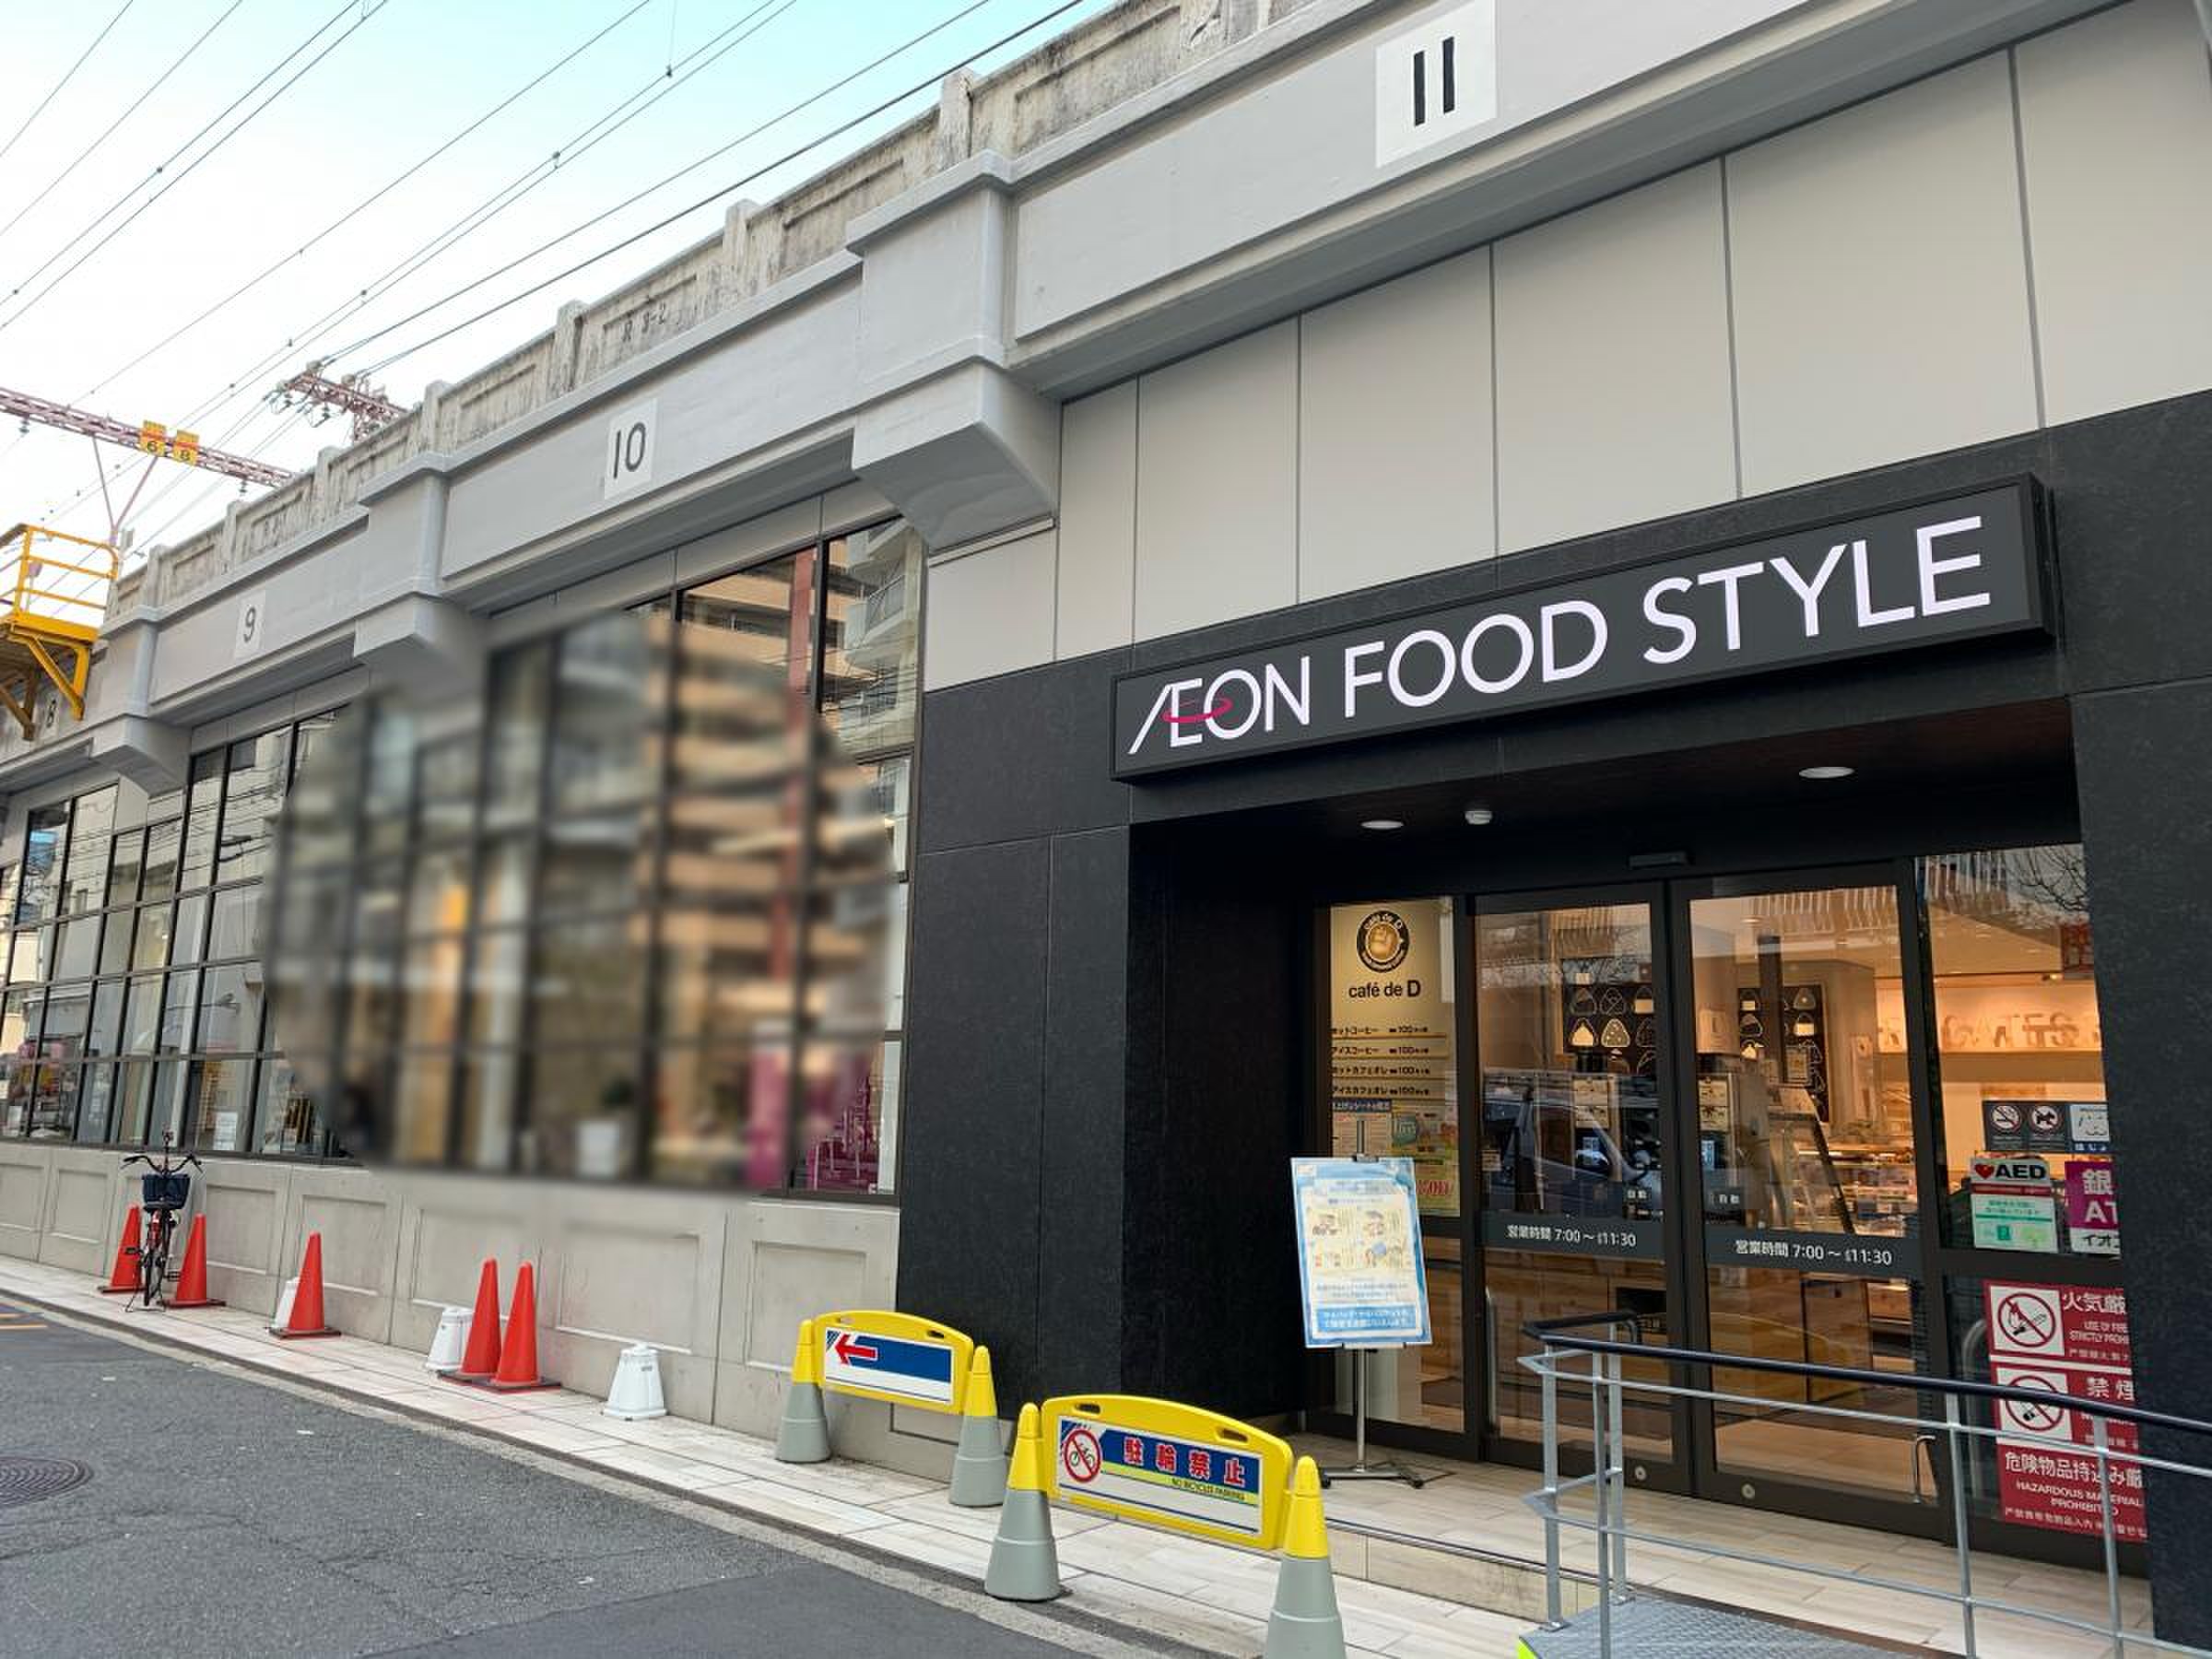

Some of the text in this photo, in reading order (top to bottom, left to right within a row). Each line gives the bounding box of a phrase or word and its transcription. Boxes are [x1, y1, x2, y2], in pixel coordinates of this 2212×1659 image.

[1414, 36, 1455, 126] 11
[614, 422, 646, 479] 10
[243, 606, 256, 642] 9
[1345, 599, 1608, 718] FOOD
[1643, 515, 1991, 665] STYLE
[1348, 979, 1421, 998] café de D
[1995, 1164, 2046, 1180] AED
[1506, 1224, 1551, 1241] 営業時間
[1735, 1240, 1789, 1257] 営業時間
[1124, 1436, 1245, 1488] 駐輪禁止
[2016, 1480, 2142, 1507] HAZARDOUS MAERIAL
[2050, 1498, 2119, 1517] PROHIBITD
